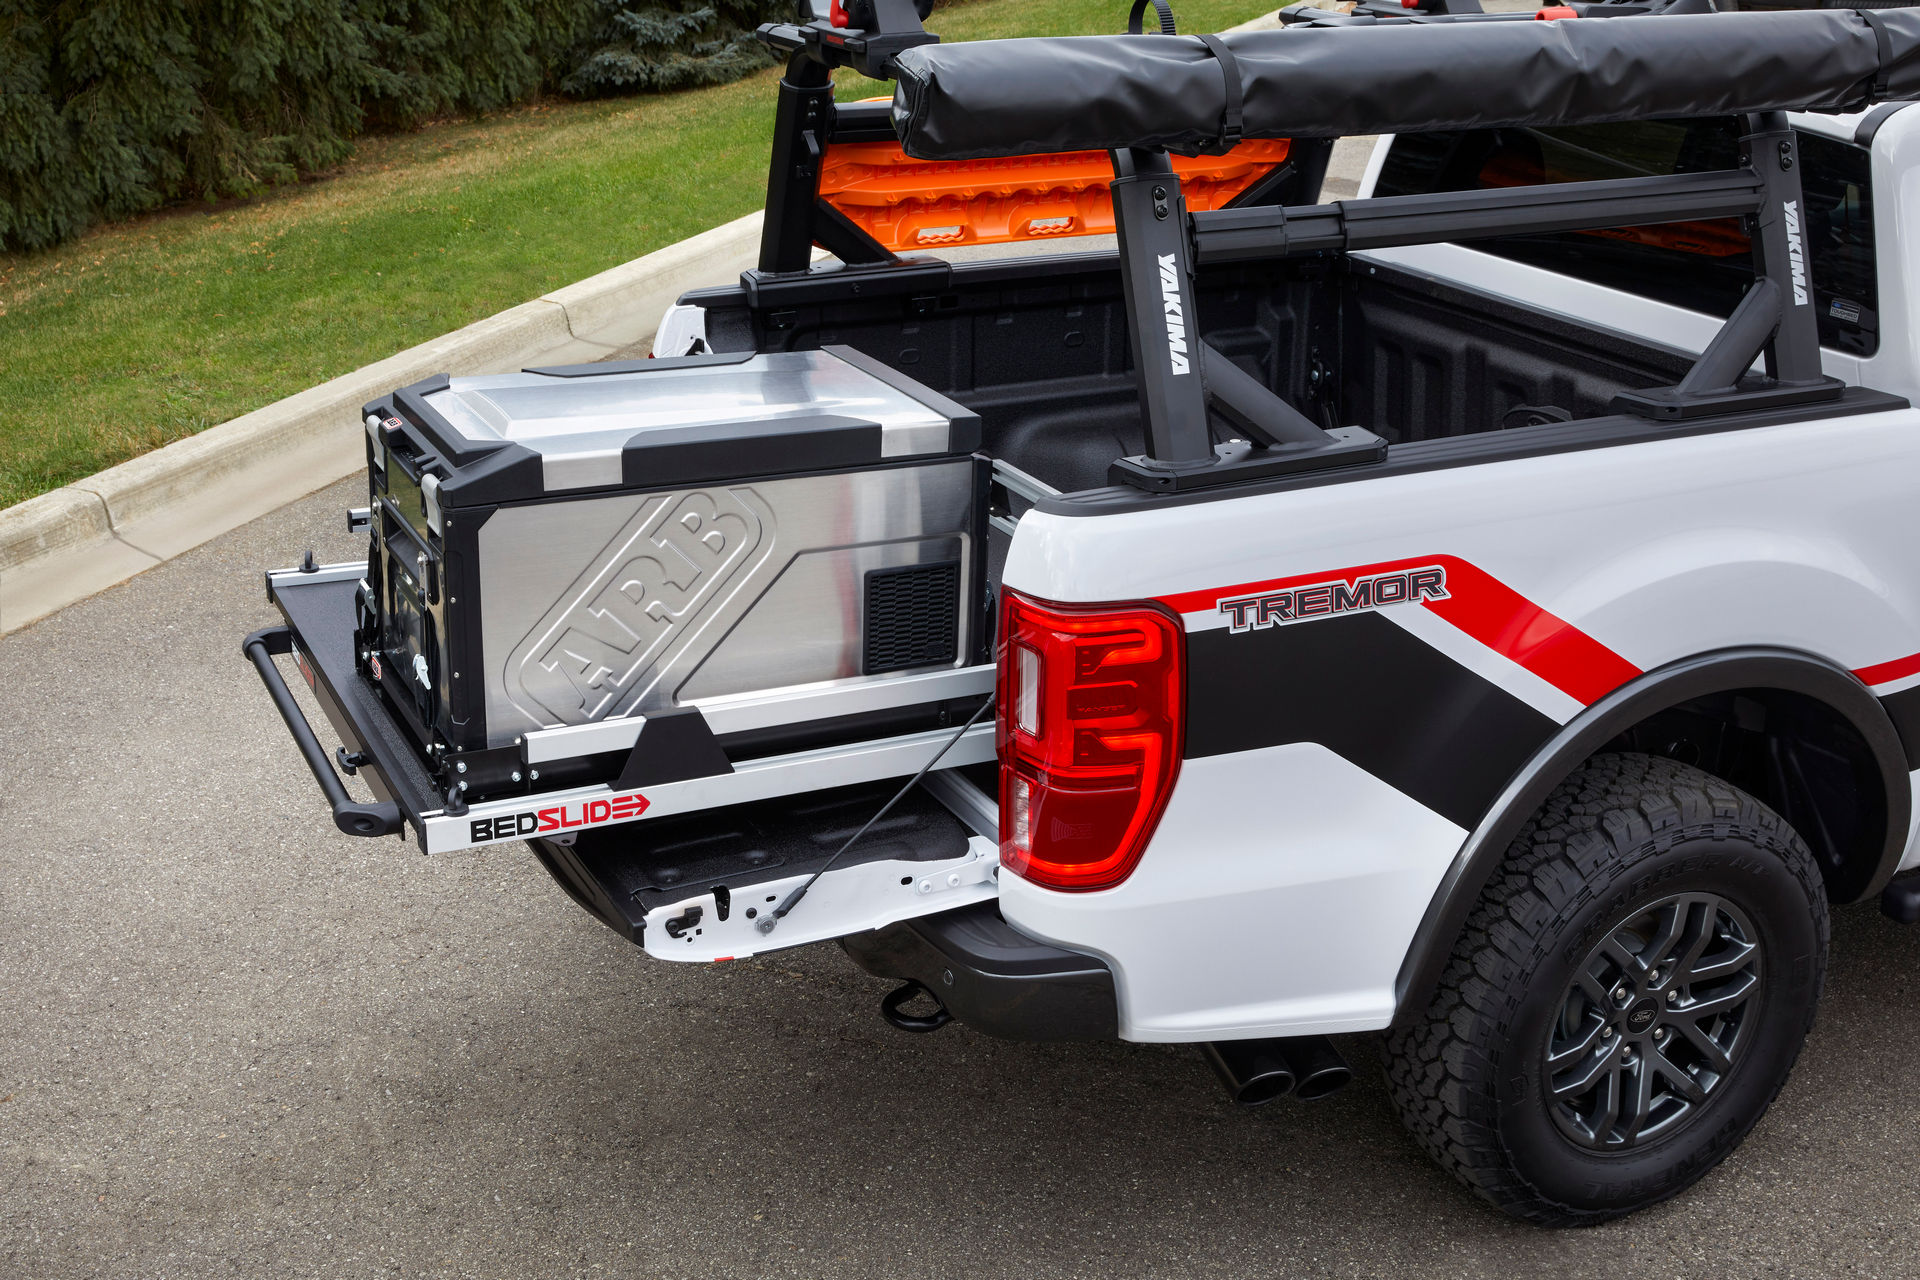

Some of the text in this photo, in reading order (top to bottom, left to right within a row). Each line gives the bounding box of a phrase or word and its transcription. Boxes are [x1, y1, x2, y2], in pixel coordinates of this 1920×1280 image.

[1784, 200, 1808, 306] YAKIMA
[1157, 253, 1190, 376] YAKIMA
[538, 491, 749, 719] ARB
[1219, 567, 1450, 631] TREMOR
